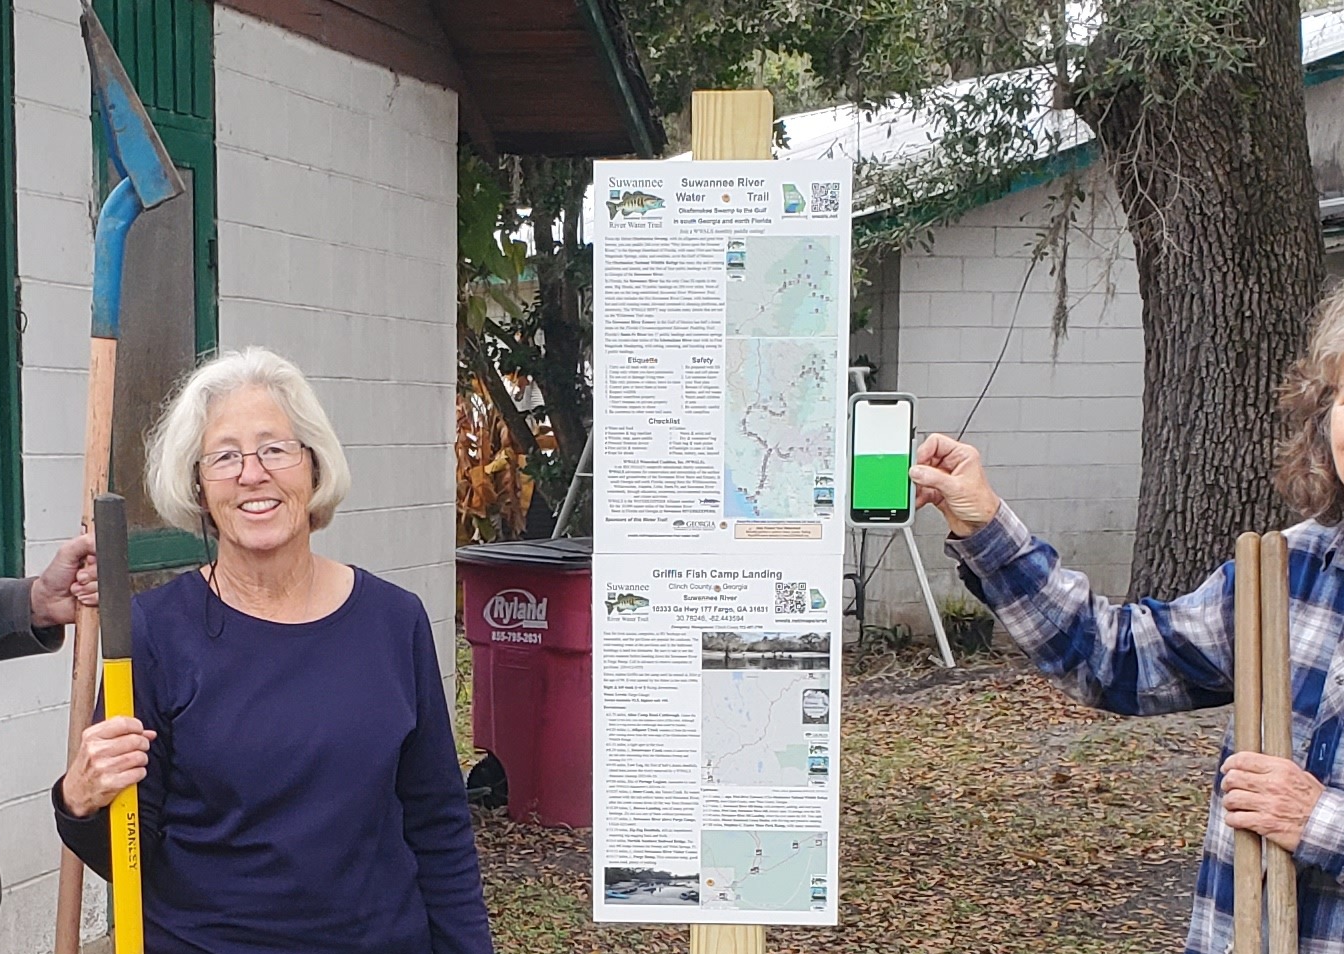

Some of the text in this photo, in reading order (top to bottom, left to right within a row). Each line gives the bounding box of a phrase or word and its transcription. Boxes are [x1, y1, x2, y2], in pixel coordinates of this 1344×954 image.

[608, 177, 663, 188] Suwannee
[681, 178, 764, 187] Suwannee River
[676, 192, 769, 202] Water Trail
[653, 570, 783, 580] Griffis Fish Camp Landing
[607, 582, 650, 590] Suwannee
[494, 596, 548, 624] Ryland
[127, 812, 138, 870] STANLEY
